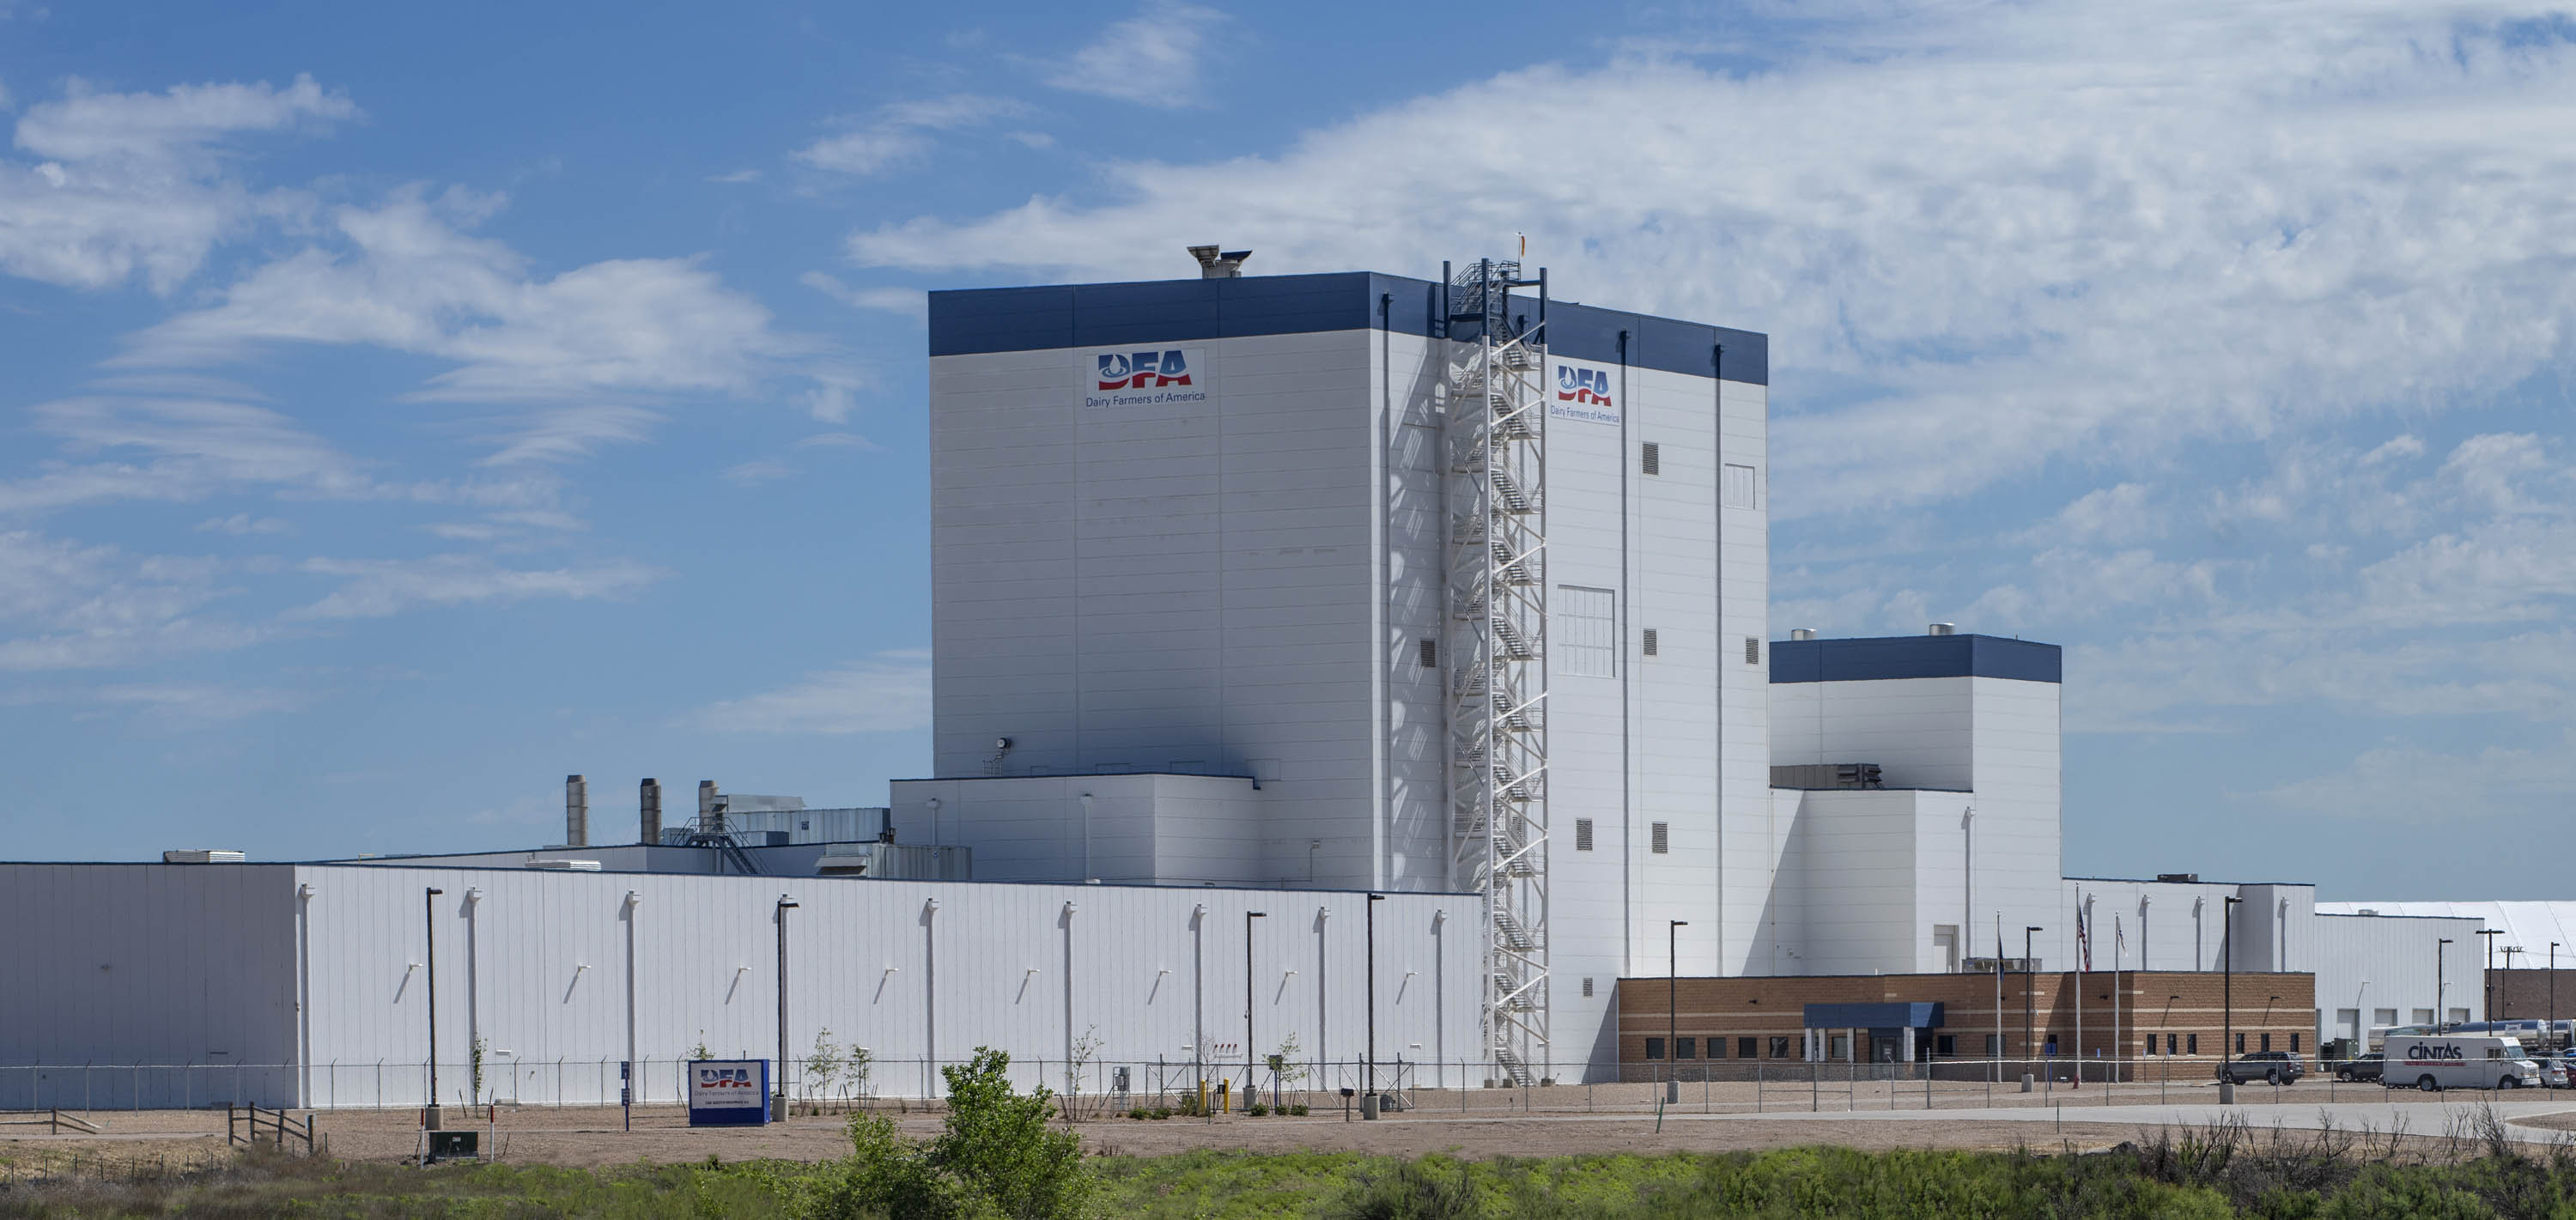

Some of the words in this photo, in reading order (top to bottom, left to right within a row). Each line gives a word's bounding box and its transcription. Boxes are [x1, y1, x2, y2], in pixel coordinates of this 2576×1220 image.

[1098, 350, 1192, 391] DFA
[1558, 365, 1612, 406] DFA
[1086, 397, 1110, 408] Dairy
[1114, 395, 1151, 405] Farmers
[1155, 394, 1164, 404] of
[1166, 391, 1206, 403] America
[1551, 405, 1566, 417] Dairy
[1567, 407, 1589, 419] Farmers
[1591, 411, 1597, 420] of
[1597, 412, 1619, 423] America
[701, 1069, 752, 1088] DFA
